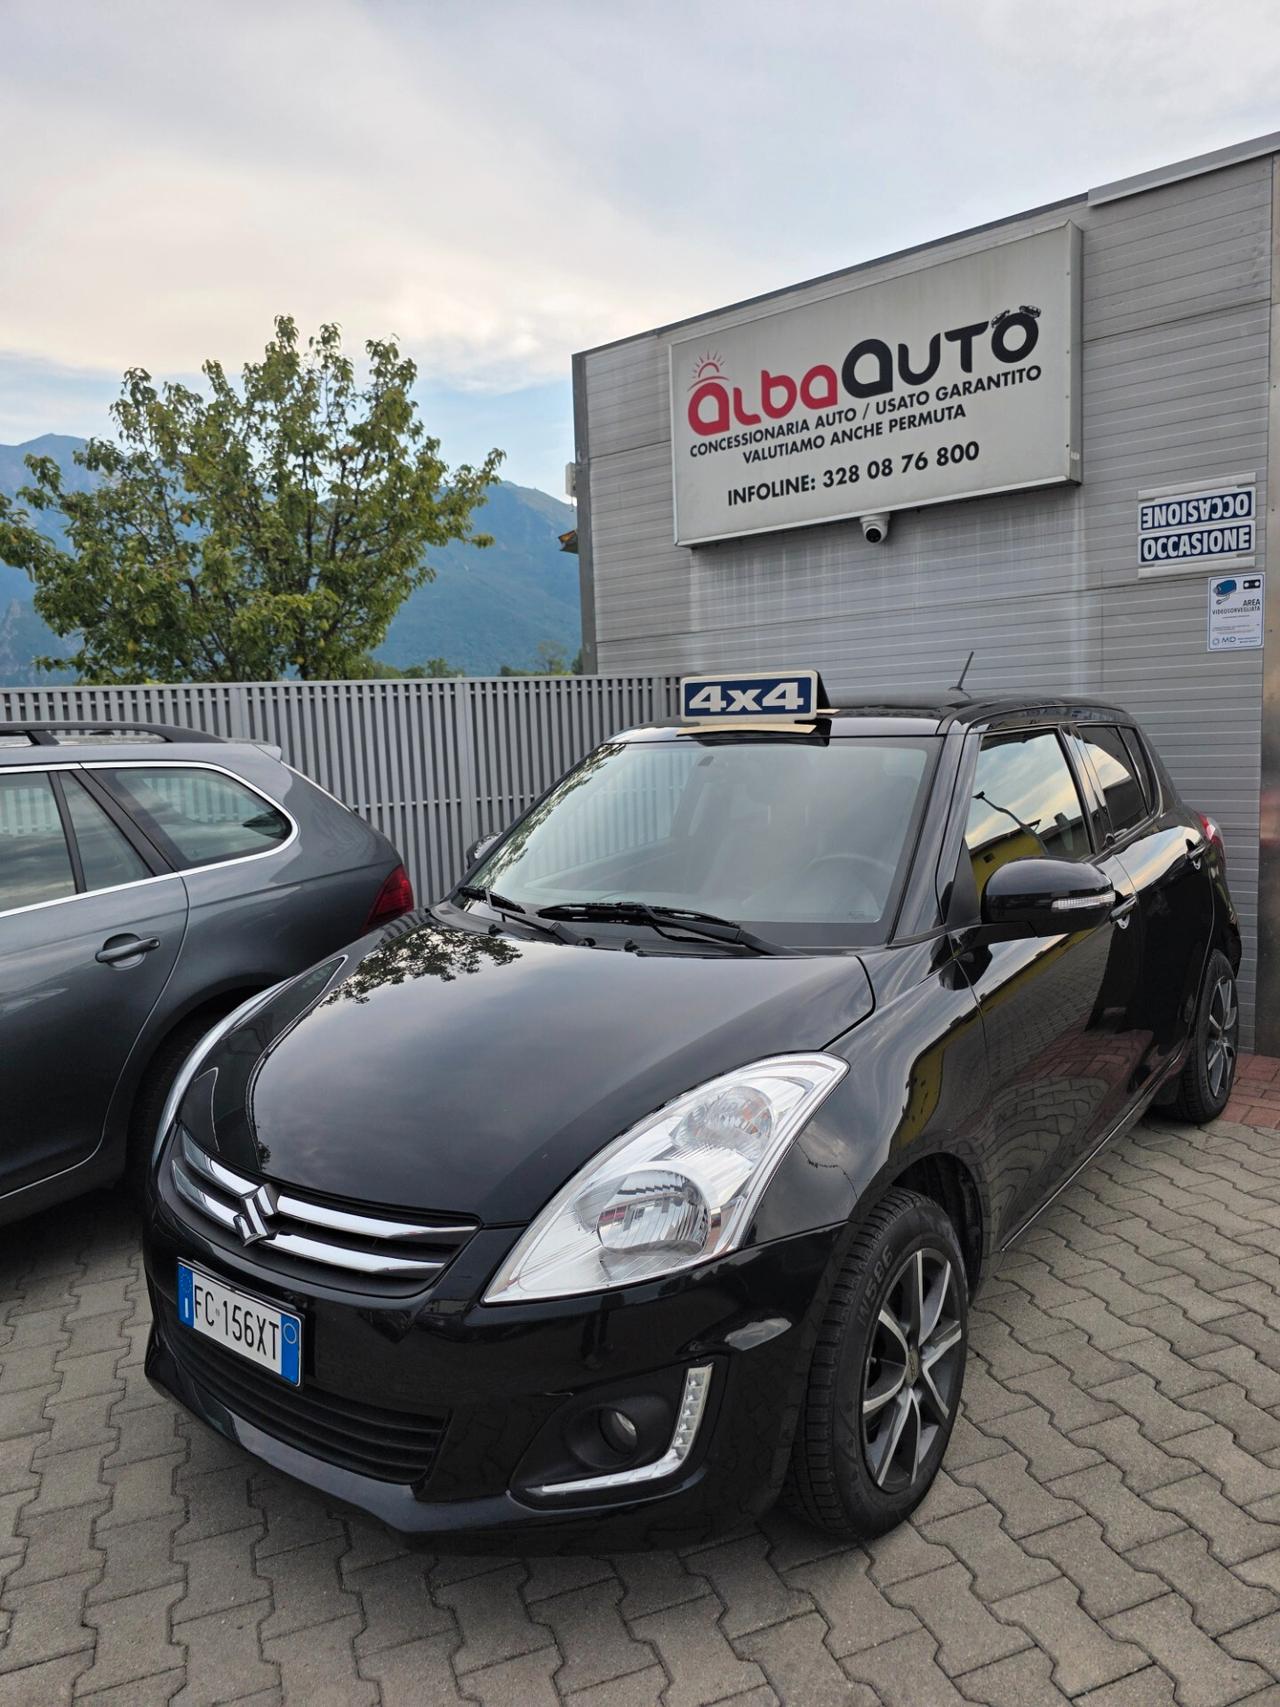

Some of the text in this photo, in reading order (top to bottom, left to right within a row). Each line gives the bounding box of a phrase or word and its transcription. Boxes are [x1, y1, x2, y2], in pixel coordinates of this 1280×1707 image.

[690, 420, 810, 458] CONCESSIONARIA
[815, 407, 857, 431] AUTO
[875, 392, 930, 415] USATO
[936, 364, 1042, 403] GARANTITO
[743, 404, 966, 465] VALUTIAMO ANCHE PERMUTA
[728, 441, 980, 506] INFOLINE: 328 08 76 800
[1143, 494, 1250, 529] OCCASIONE
[1143, 526, 1250, 560] OCCASIONE
[1243, 598, 1261, 606] AREA
[689, 682, 804, 712] 4x4
